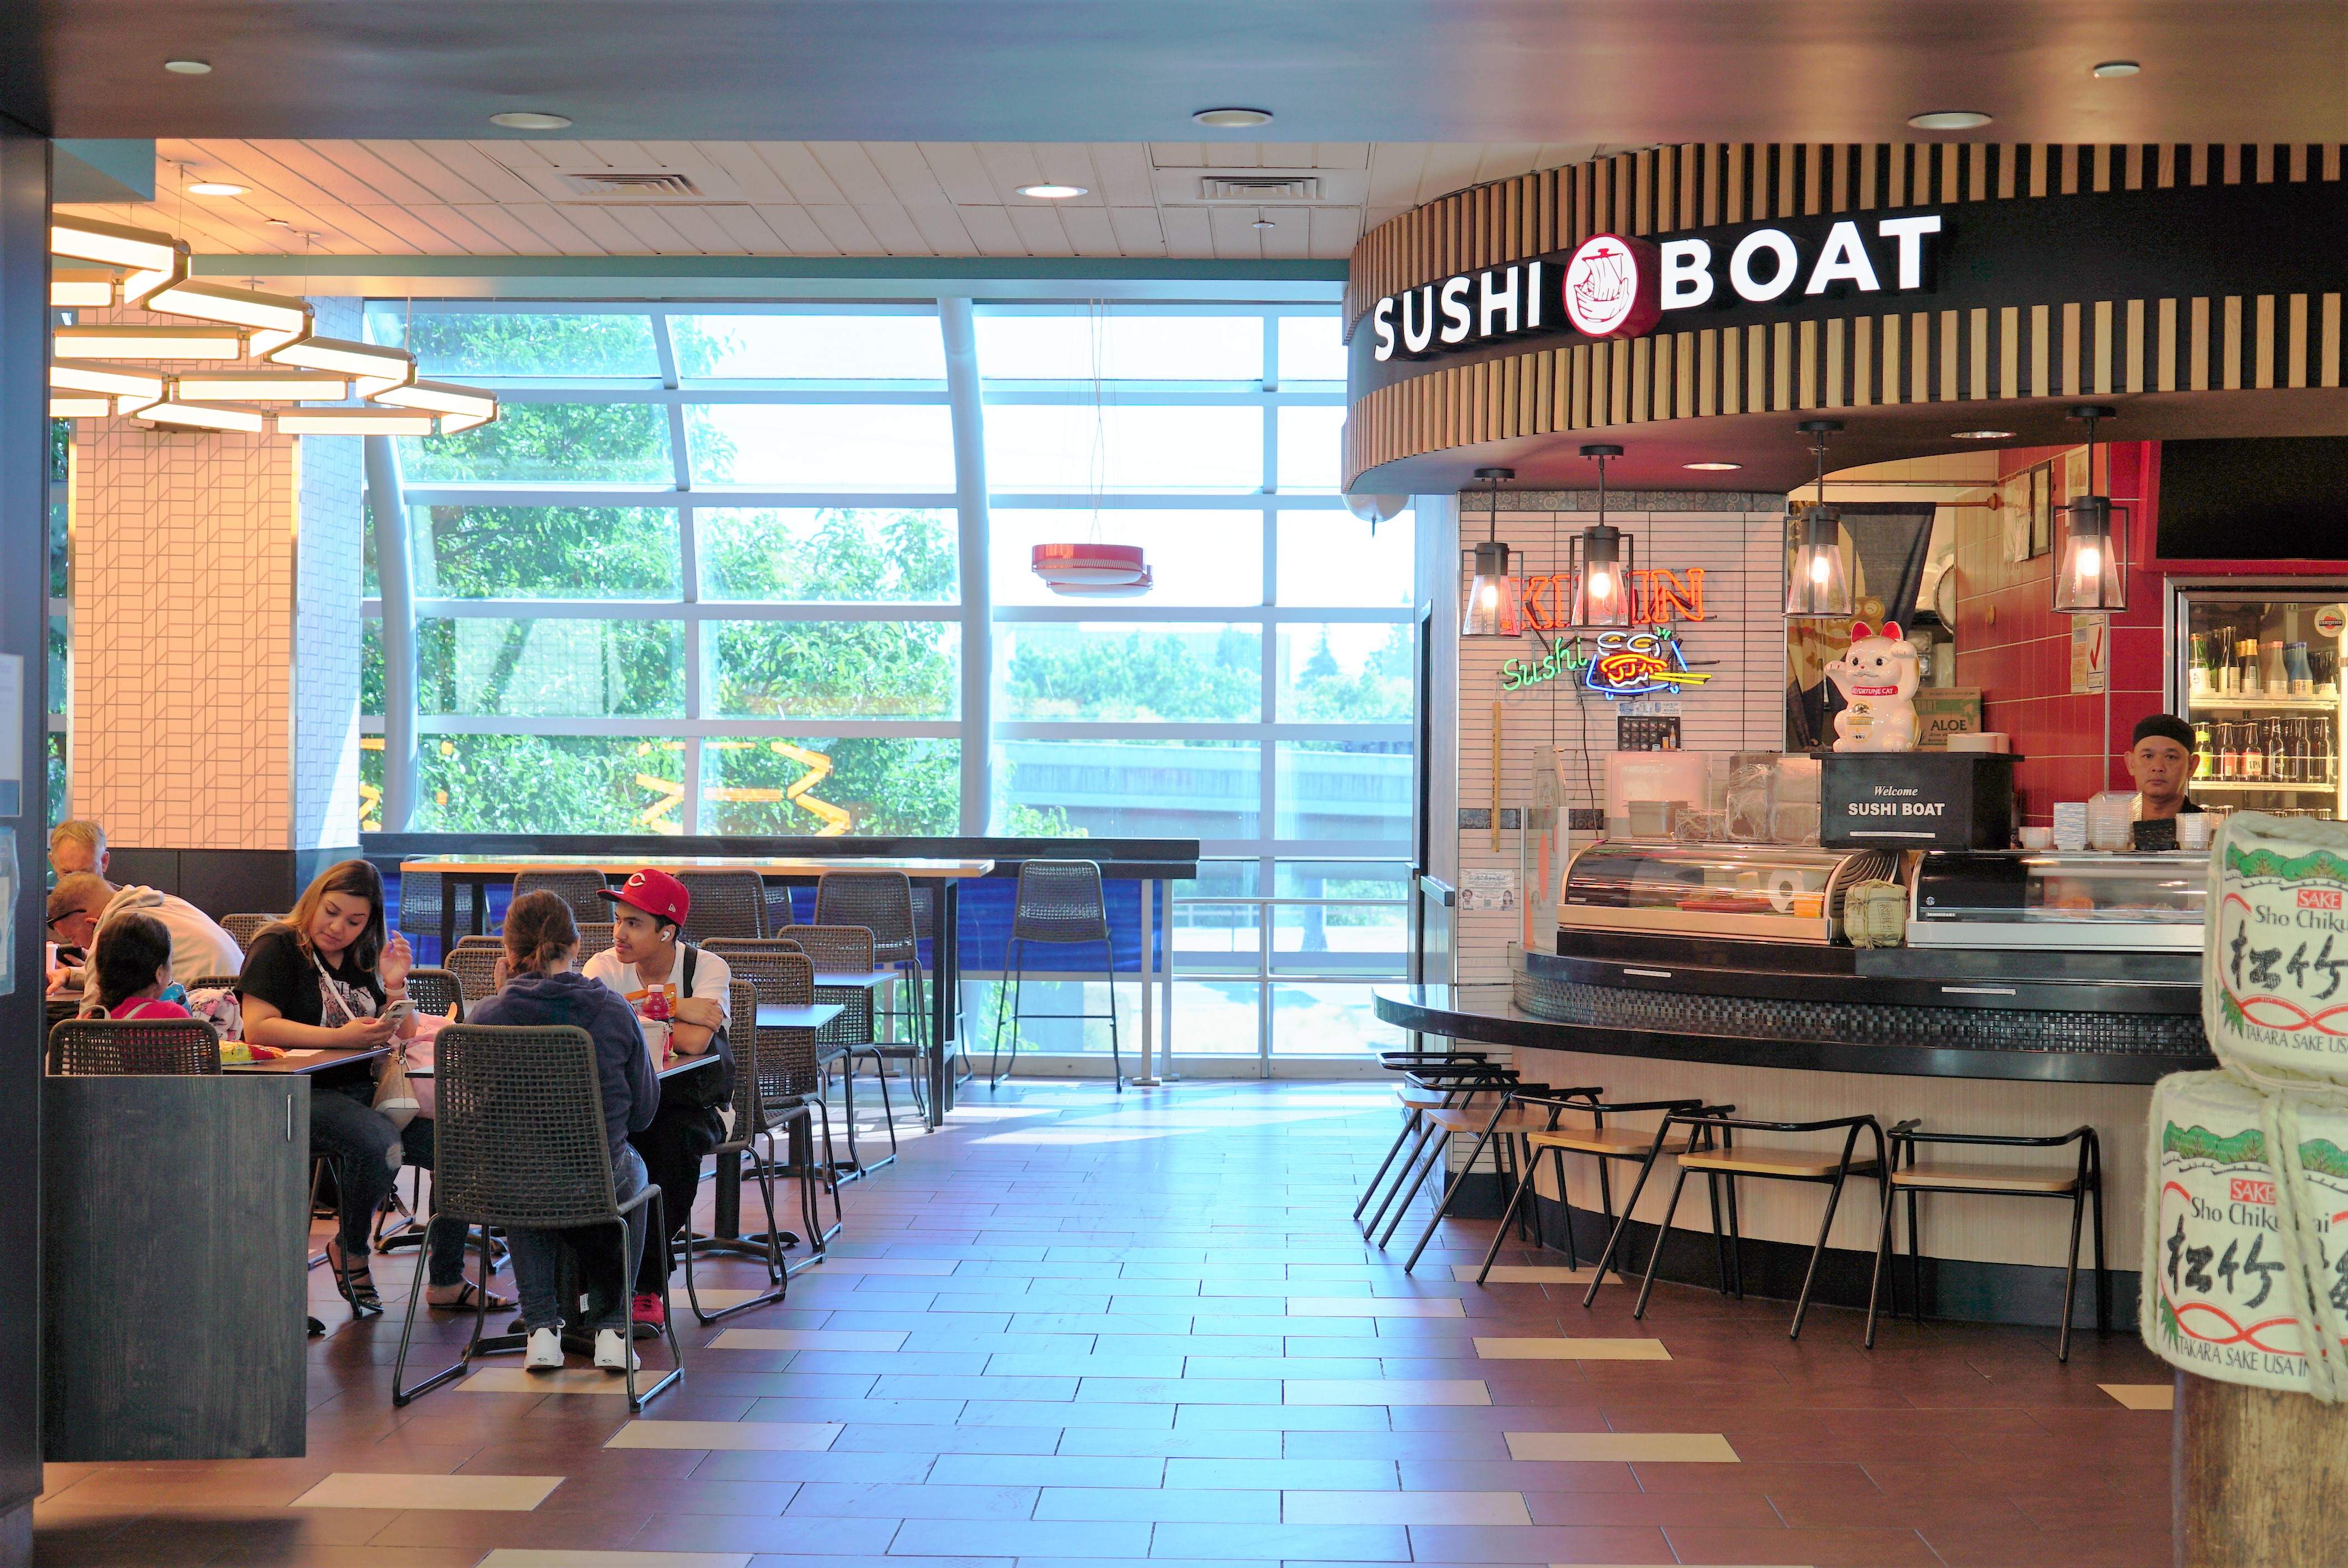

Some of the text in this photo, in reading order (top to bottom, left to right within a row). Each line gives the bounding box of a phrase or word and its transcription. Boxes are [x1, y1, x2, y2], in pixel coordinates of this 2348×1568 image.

[1373, 215, 1941, 362] SUSHI BOAT
[1502, 637, 1588, 691] Sushi
[1931, 720, 1966, 730] ALOE
[2249, 761, 2261, 770] IPA
[1875, 786, 1918, 796] Welcome
[1848, 803, 1945, 816] SUSHI BOAT
[628, 873, 646, 886] C
[2299, 890, 2340, 908] SAKE
[2256, 905, 2289, 927] Sho
[2246, 1024, 2288, 1048] TAKARA
[2293, 1033, 2323, 1052] SAKE
[2232, 1181, 2275, 1203] SAKE
[2191, 1197, 2222, 1222] Sho
[2179, 1335, 2221, 1364] TAKARA
[2226, 1347, 2258, 1371] SAKE
[2264, 1356, 2294, 1377] USA
